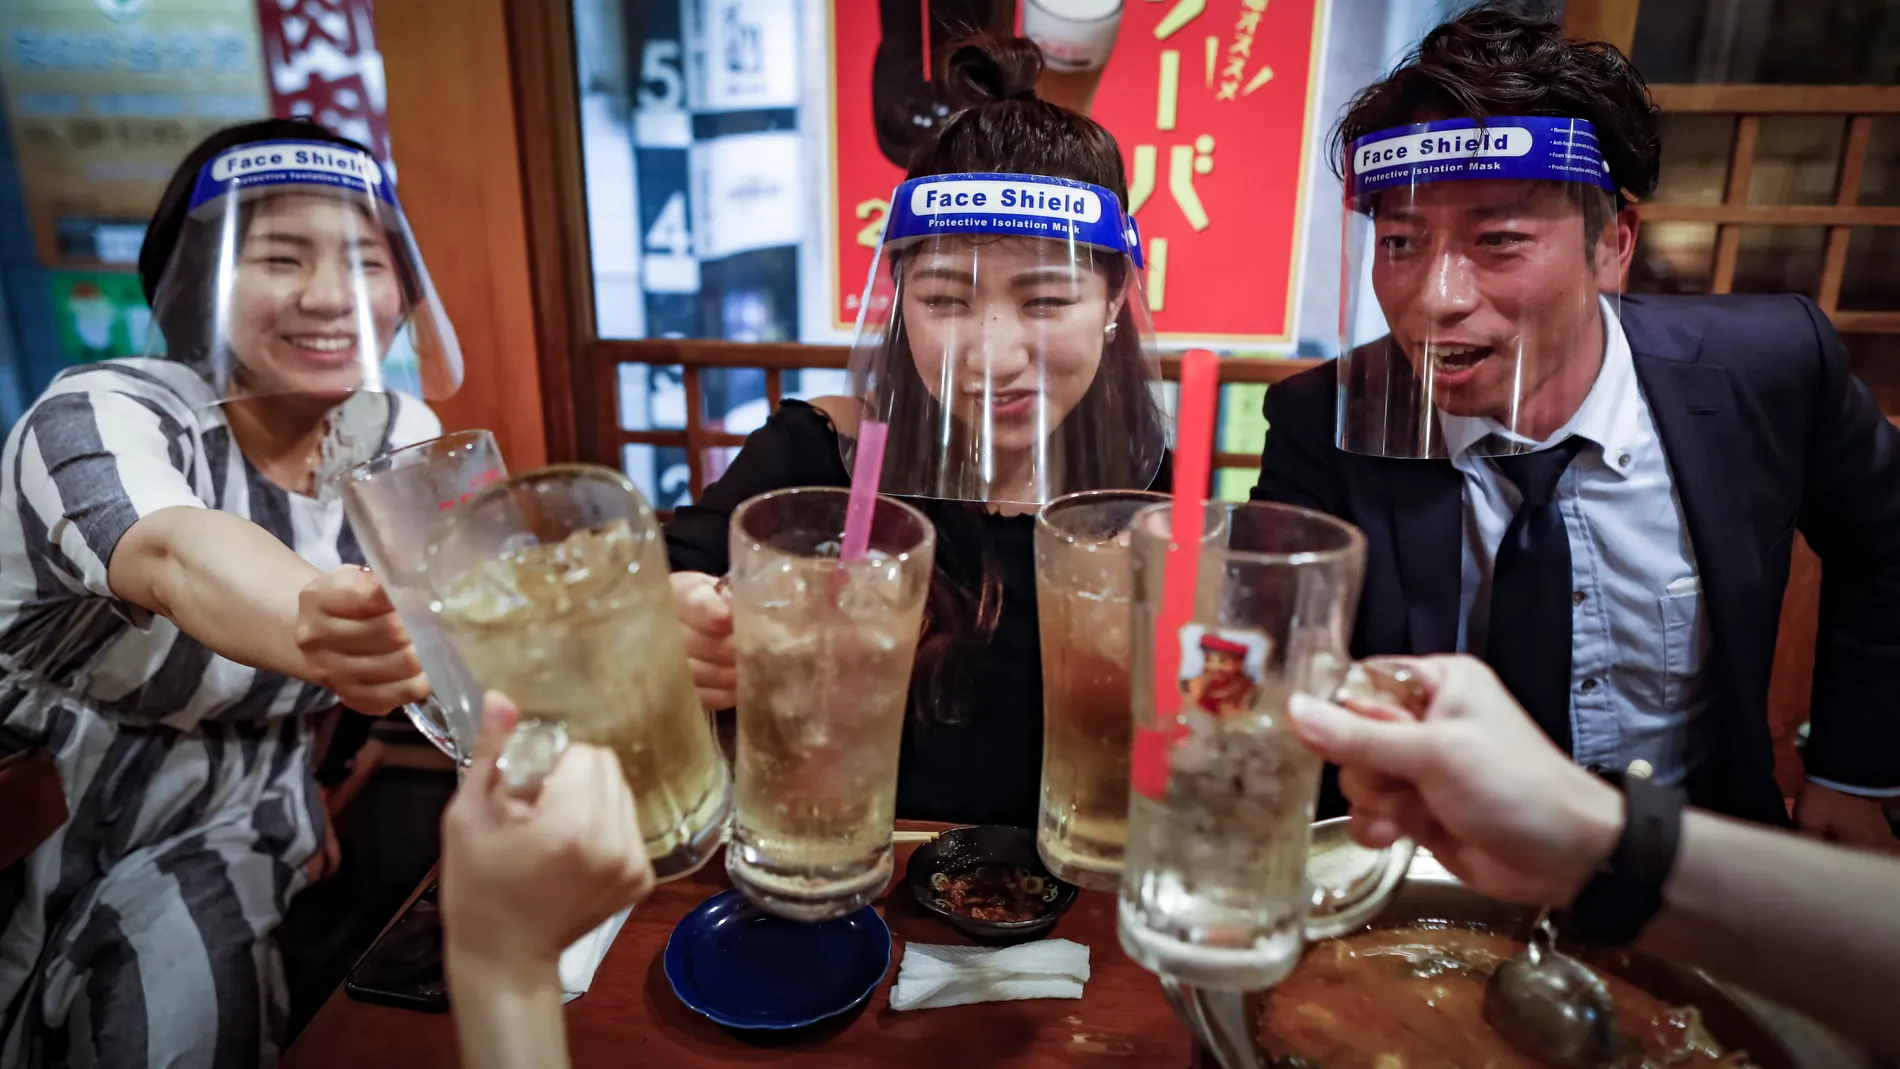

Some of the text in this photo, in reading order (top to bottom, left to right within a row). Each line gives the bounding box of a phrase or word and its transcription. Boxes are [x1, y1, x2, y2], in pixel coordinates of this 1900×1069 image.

[636, 40, 684, 102] 5
[227, 152, 283, 173] Face
[1363, 134, 1508, 167] Face Shield
[1364, 161, 1501, 184] Protective Isolation Mask
[926, 188, 1086, 215] Face Shield
[645, 190, 691, 257] 4
[928, 217, 988, 228] Protective
[993, 217, 1048, 230] Isolation
